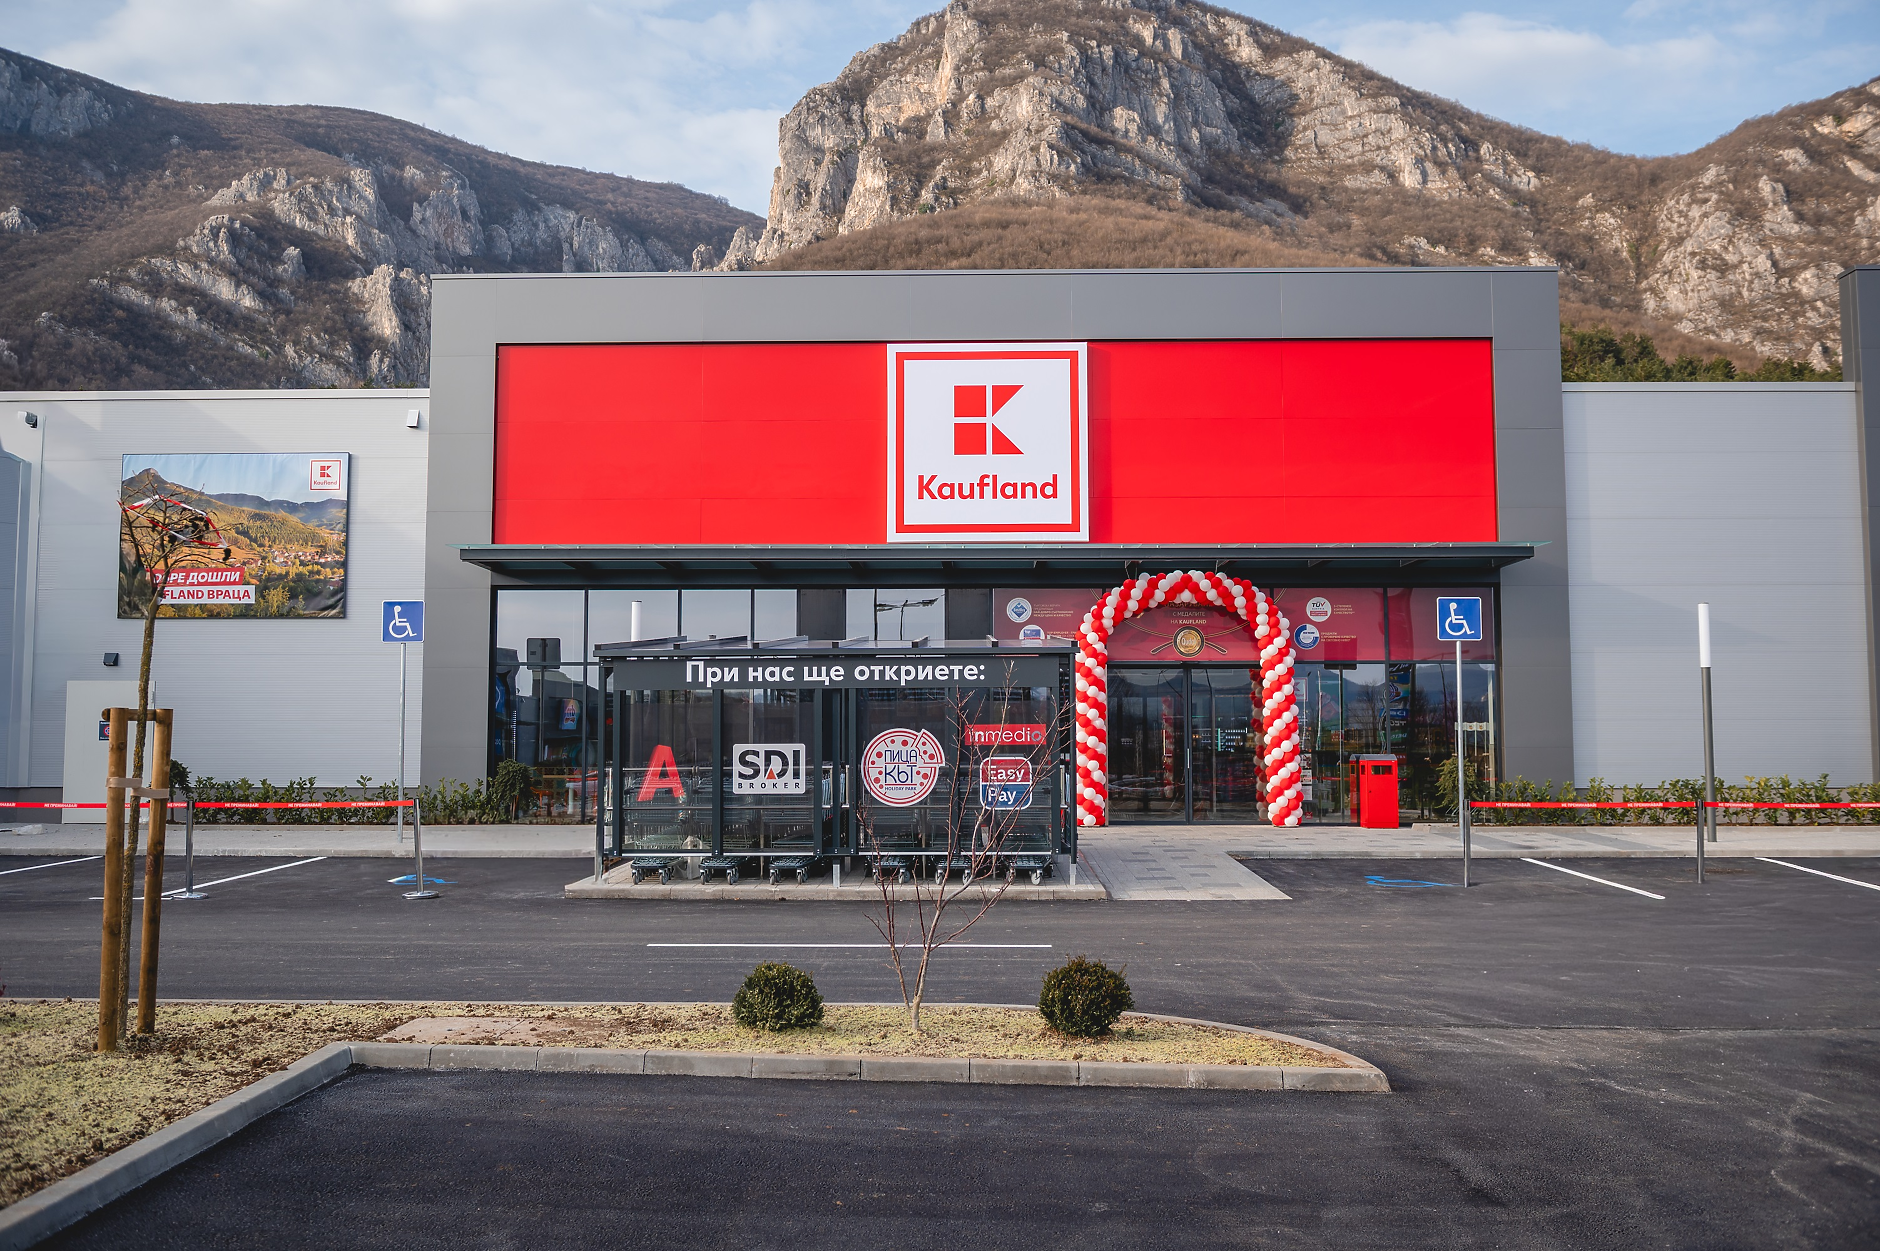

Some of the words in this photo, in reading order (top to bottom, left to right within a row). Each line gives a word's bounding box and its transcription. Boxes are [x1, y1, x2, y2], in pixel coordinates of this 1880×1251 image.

[917, 474, 1058, 500] Kaufland
[186, 572, 240, 585] ДОШЛИ
[163, 590, 205, 600] FLAND
[207, 589, 251, 602] ВРАЦА
[686, 661, 739, 687] При
[748, 664, 795, 682] нас
[803, 664, 845, 685] ще
[854, 663, 985, 686] откриете:
[968, 727, 1042, 742] inmedio
[738, 749, 801, 780] SDI
[884, 750, 917, 764] ПИЦА
[988, 766, 1024, 782] Easy
[988, 787, 1016, 805] Pay
